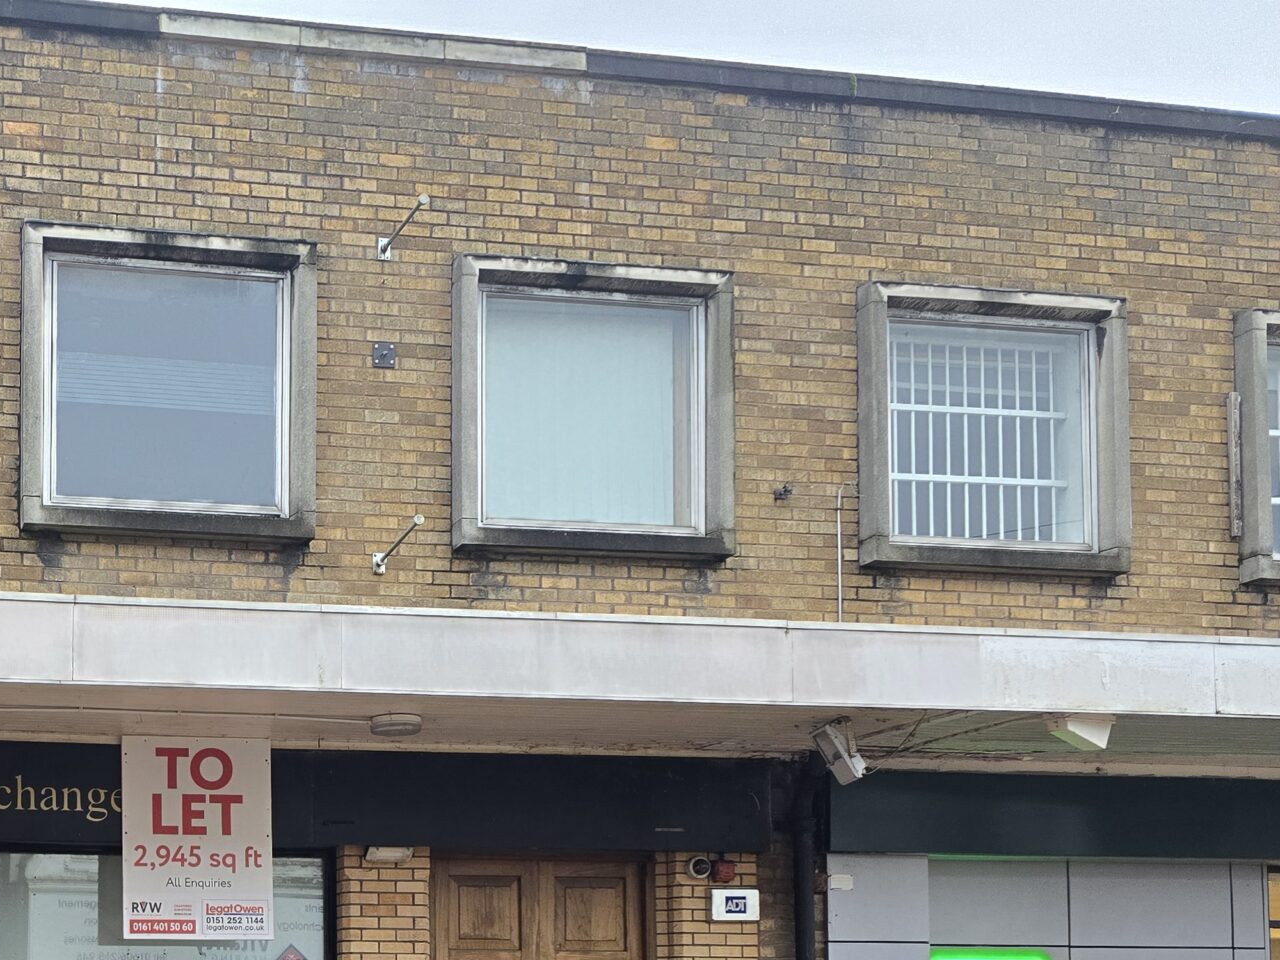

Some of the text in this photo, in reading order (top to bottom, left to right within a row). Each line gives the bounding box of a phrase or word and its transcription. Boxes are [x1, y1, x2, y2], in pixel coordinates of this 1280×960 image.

[155, 747, 233, 791] TO
[152, 793, 243, 836] LET
[133, 844, 263, 874] 2,945 sq ft
[166, 877, 232, 890] All Enquiries
[131, 901, 162, 913] RVW
[726, 899, 746, 912] ADT
[133, 922, 193, 931] 0161 401 50 60
[206, 916, 224, 924] 0151
[246, 916, 264, 924] 1144
[206, 924, 265, 933] legatowen.co.uk
